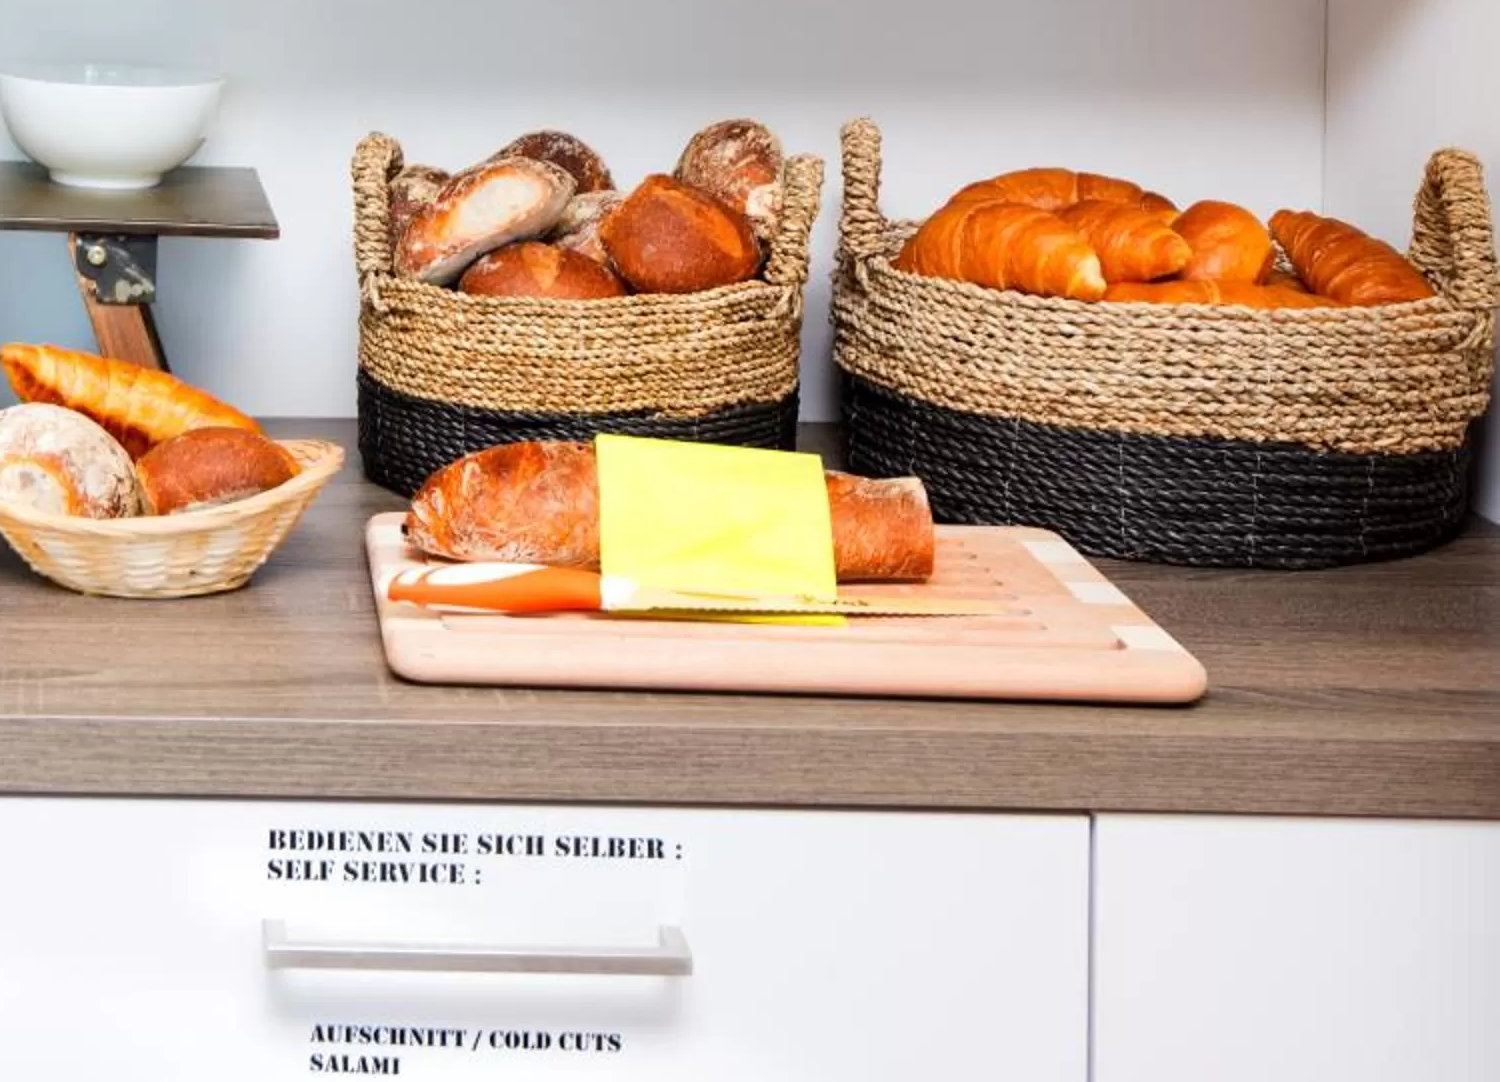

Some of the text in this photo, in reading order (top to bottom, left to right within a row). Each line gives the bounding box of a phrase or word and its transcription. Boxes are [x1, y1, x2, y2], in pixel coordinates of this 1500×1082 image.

[268, 829, 413, 854] BEDIENEN
[420, 832, 469, 856] SIE
[476, 833, 545, 858] SICH
[554, 835, 666, 860] SELBER
[266, 859, 336, 882] SELF
[342, 861, 467, 885] SERVICE
[309, 1023, 469, 1049] AUFSCHNITT
[488, 1030, 553, 1051] COLD
[558, 1031, 623, 1053] CUTS
[309, 1053, 402, 1076] SALAMI
